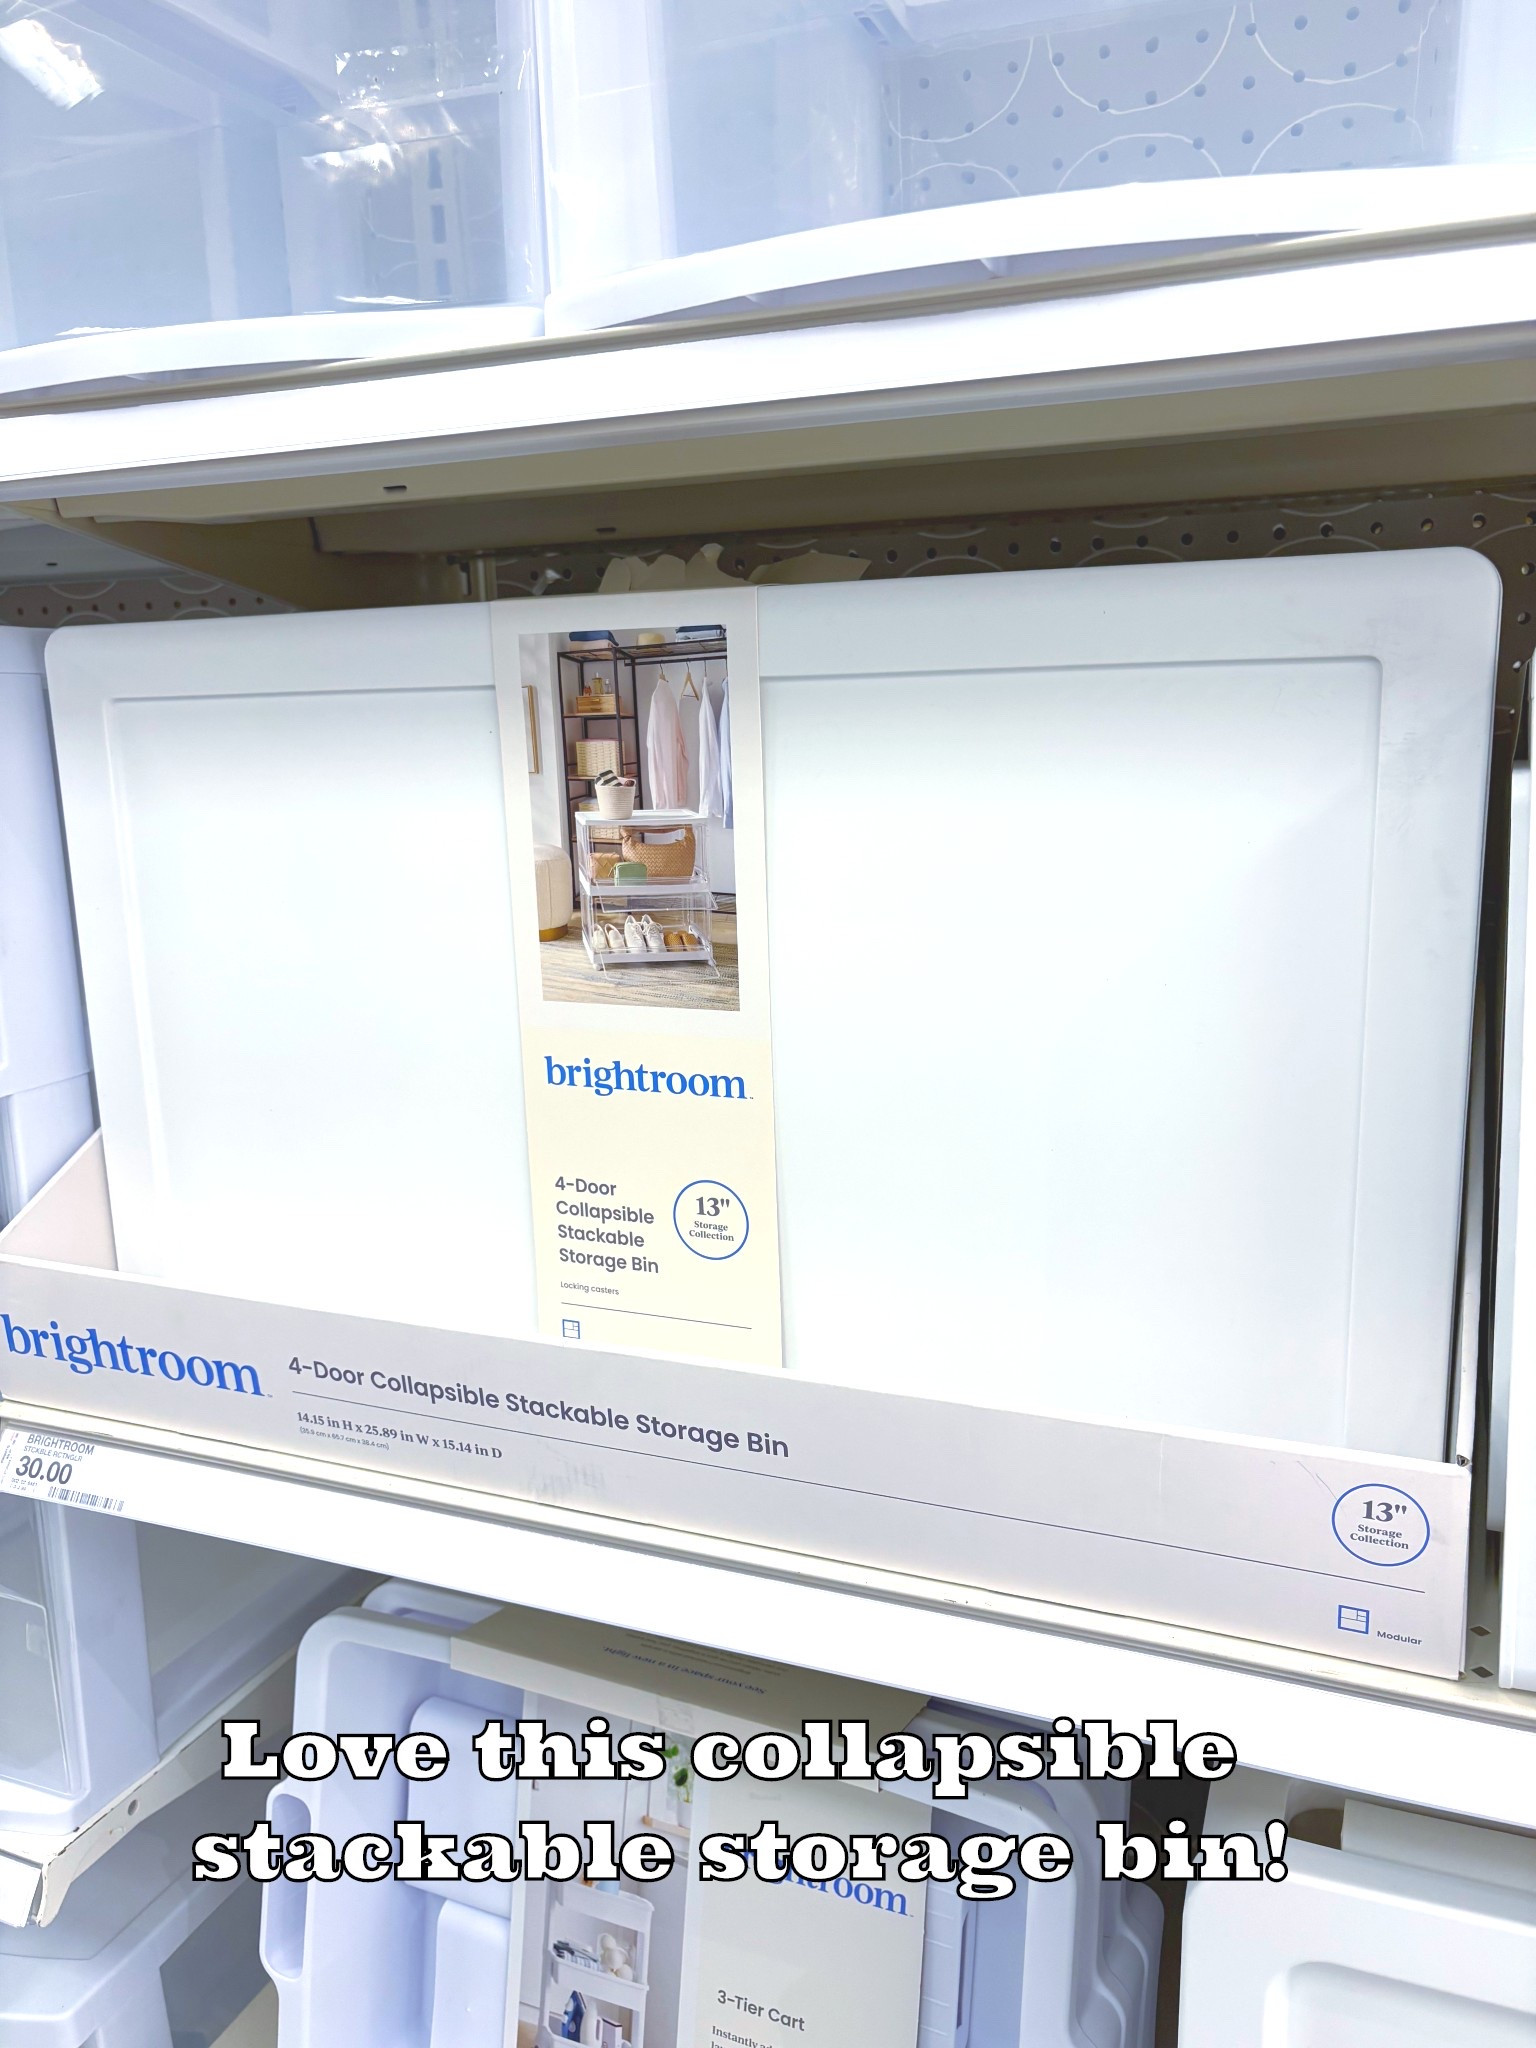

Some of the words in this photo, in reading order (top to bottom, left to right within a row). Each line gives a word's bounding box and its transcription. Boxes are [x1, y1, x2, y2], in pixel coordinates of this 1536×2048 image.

[544, 1055, 748, 1100] brightroom
[555, 1176, 617, 1196] 4-Door
[556, 1200, 655, 1225] Collapsible
[695, 1196, 731, 1217] 13"
[557, 1224, 645, 1248] Stackable
[689, 1229, 735, 1242] Collection
[694, 1220, 729, 1233] Storage
[559, 1248, 628, 1272] Storage
[632, 1256, 660, 1274] Bin
[560, 1281, 590, 1294] Locking
[590, 1285, 620, 1296] casters
[0, 1314, 266, 1397] brightroom
[288, 1356, 365, 1386] 4-Door
[370, 1371, 500, 1409] Collapsible
[505, 1393, 630, 1431] Stackable
[636, 1414, 740, 1453] Storage
[747, 1431, 790, 1458] Bin
[27, 1433, 95, 1456] BRIGHTROOM
[296, 1411, 325, 1426] 14.15
[326, 1416, 340, 1429] in
[342, 1419, 354, 1432] H
[355, 1423, 363, 1433] x
[364, 1424, 398, 1440] 25.89
[400, 1430, 414, 1443] in
[416, 1433, 430, 1445] W
[432, 1438, 441, 1448] x
[443, 1438, 473, 1454] 15.14
[475, 1443, 489, 1457] in
[491, 1447, 503, 1459] D
[15, 1455, 73, 1485] 30.00
[1361, 1500, 1408, 1523] 13"
[1350, 1532, 1410, 1550] Collection
[1357, 1523, 1403, 1539] Storage
[1376, 1630, 1423, 1646] Modular
[717, 1989, 765, 2018] 3-Tier
[768, 2008, 806, 2032] Cart
